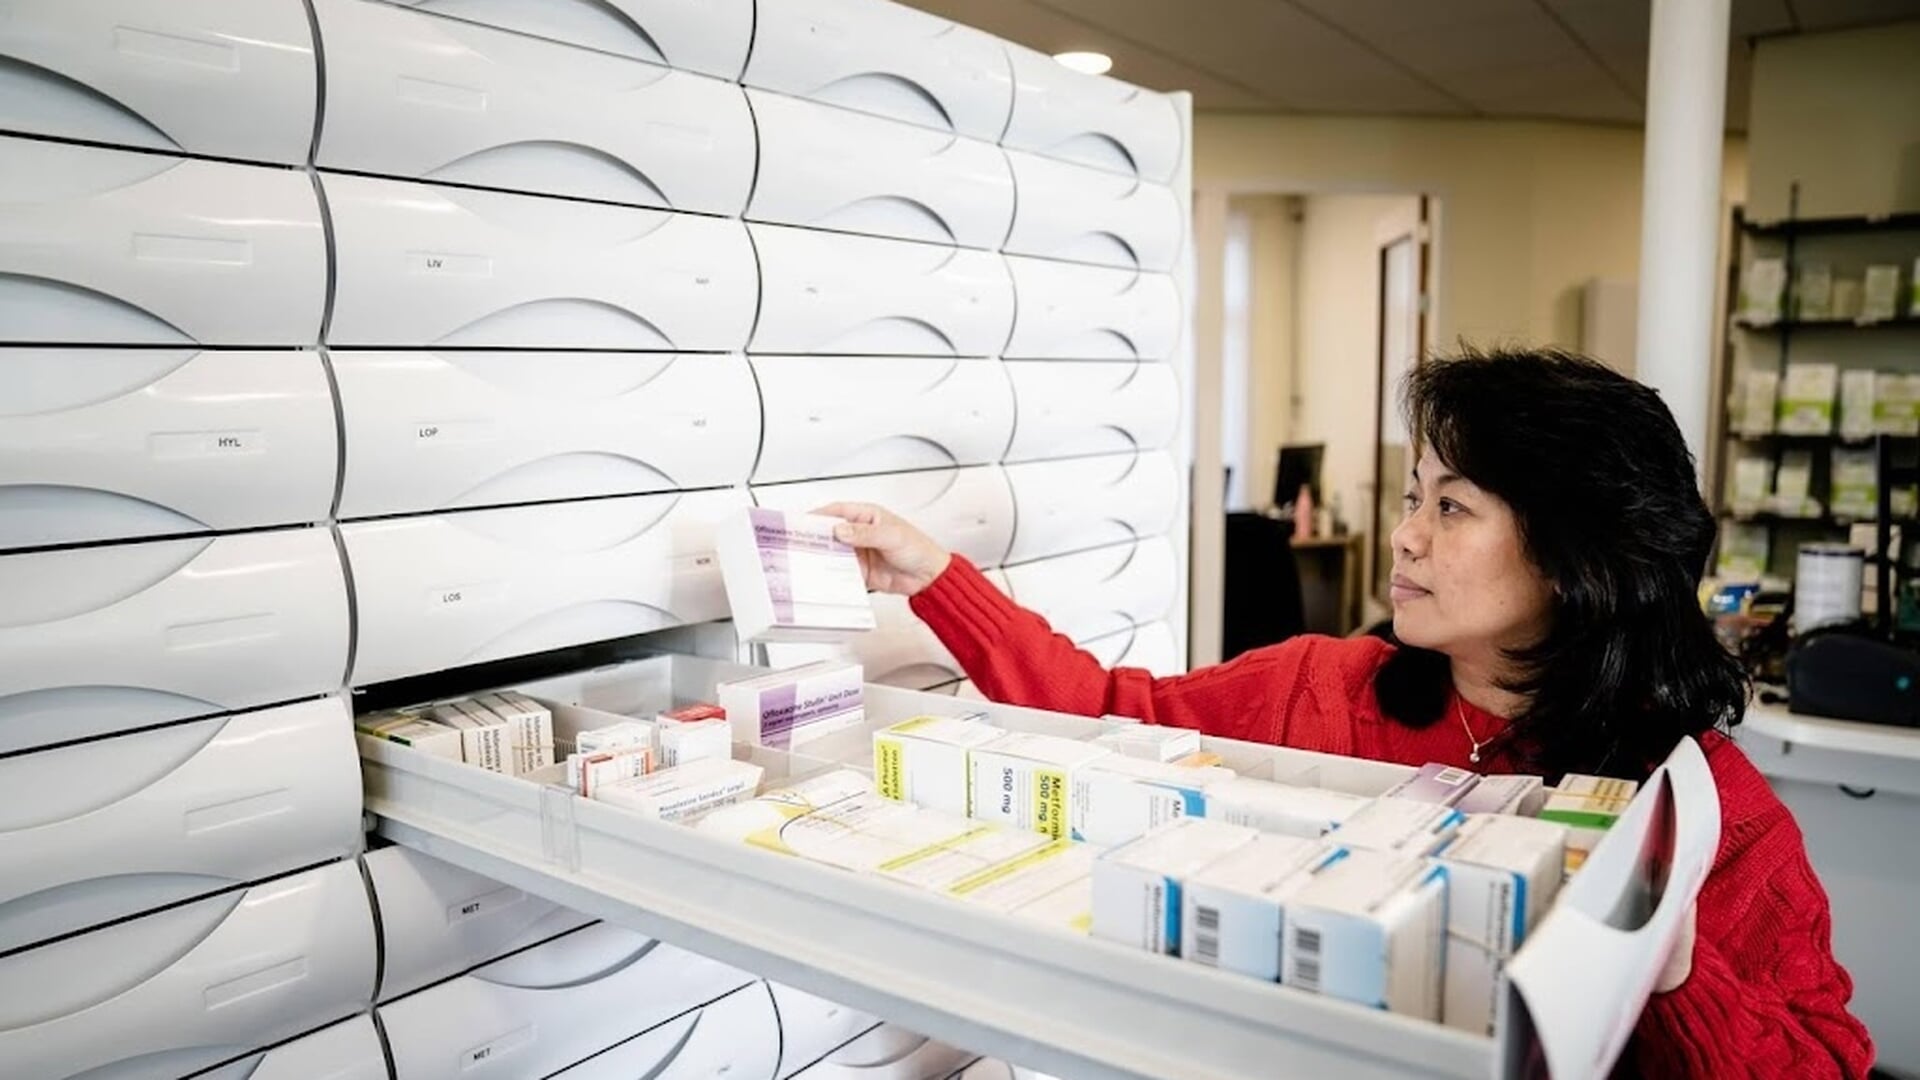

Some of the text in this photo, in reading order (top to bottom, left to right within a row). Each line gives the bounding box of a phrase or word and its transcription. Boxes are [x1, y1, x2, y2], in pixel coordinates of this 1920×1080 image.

[427, 258, 443, 269] LIV
[419, 427, 438, 438] LOP
[218, 437, 241, 448] HYL
[443, 592, 462, 603] LOS
[828, 691, 842, 703] Unit
[844, 687, 860, 698] Dose
[1002, 767, 1014, 815] 500 mg
[1040, 775, 1050, 799] 500
[461, 903, 480, 914] MET
[472, 1047, 491, 1060] MET
